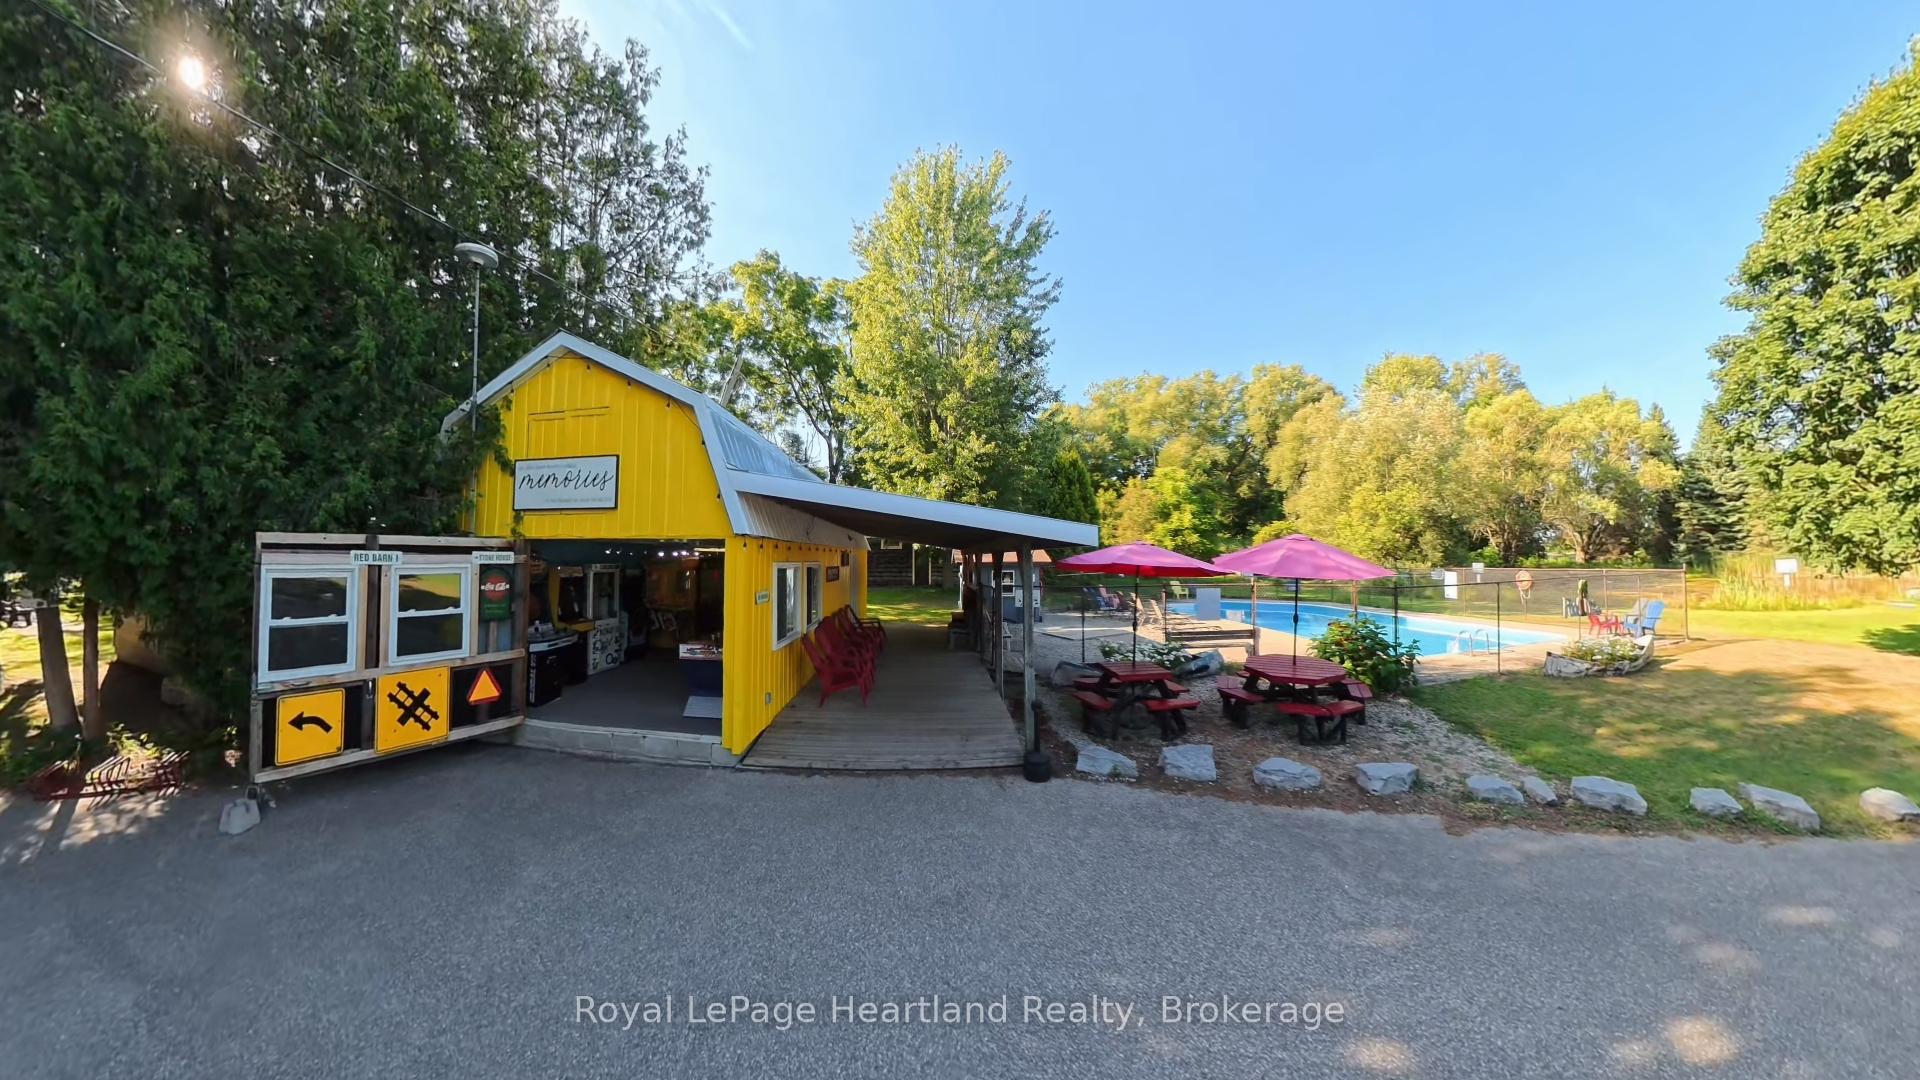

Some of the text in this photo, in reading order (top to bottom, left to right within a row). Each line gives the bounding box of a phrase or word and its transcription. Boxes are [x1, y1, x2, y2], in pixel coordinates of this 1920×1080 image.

[518, 469, 614, 491] memories
[353, 553, 370, 562] RED
[372, 553, 393, 563] BARN
